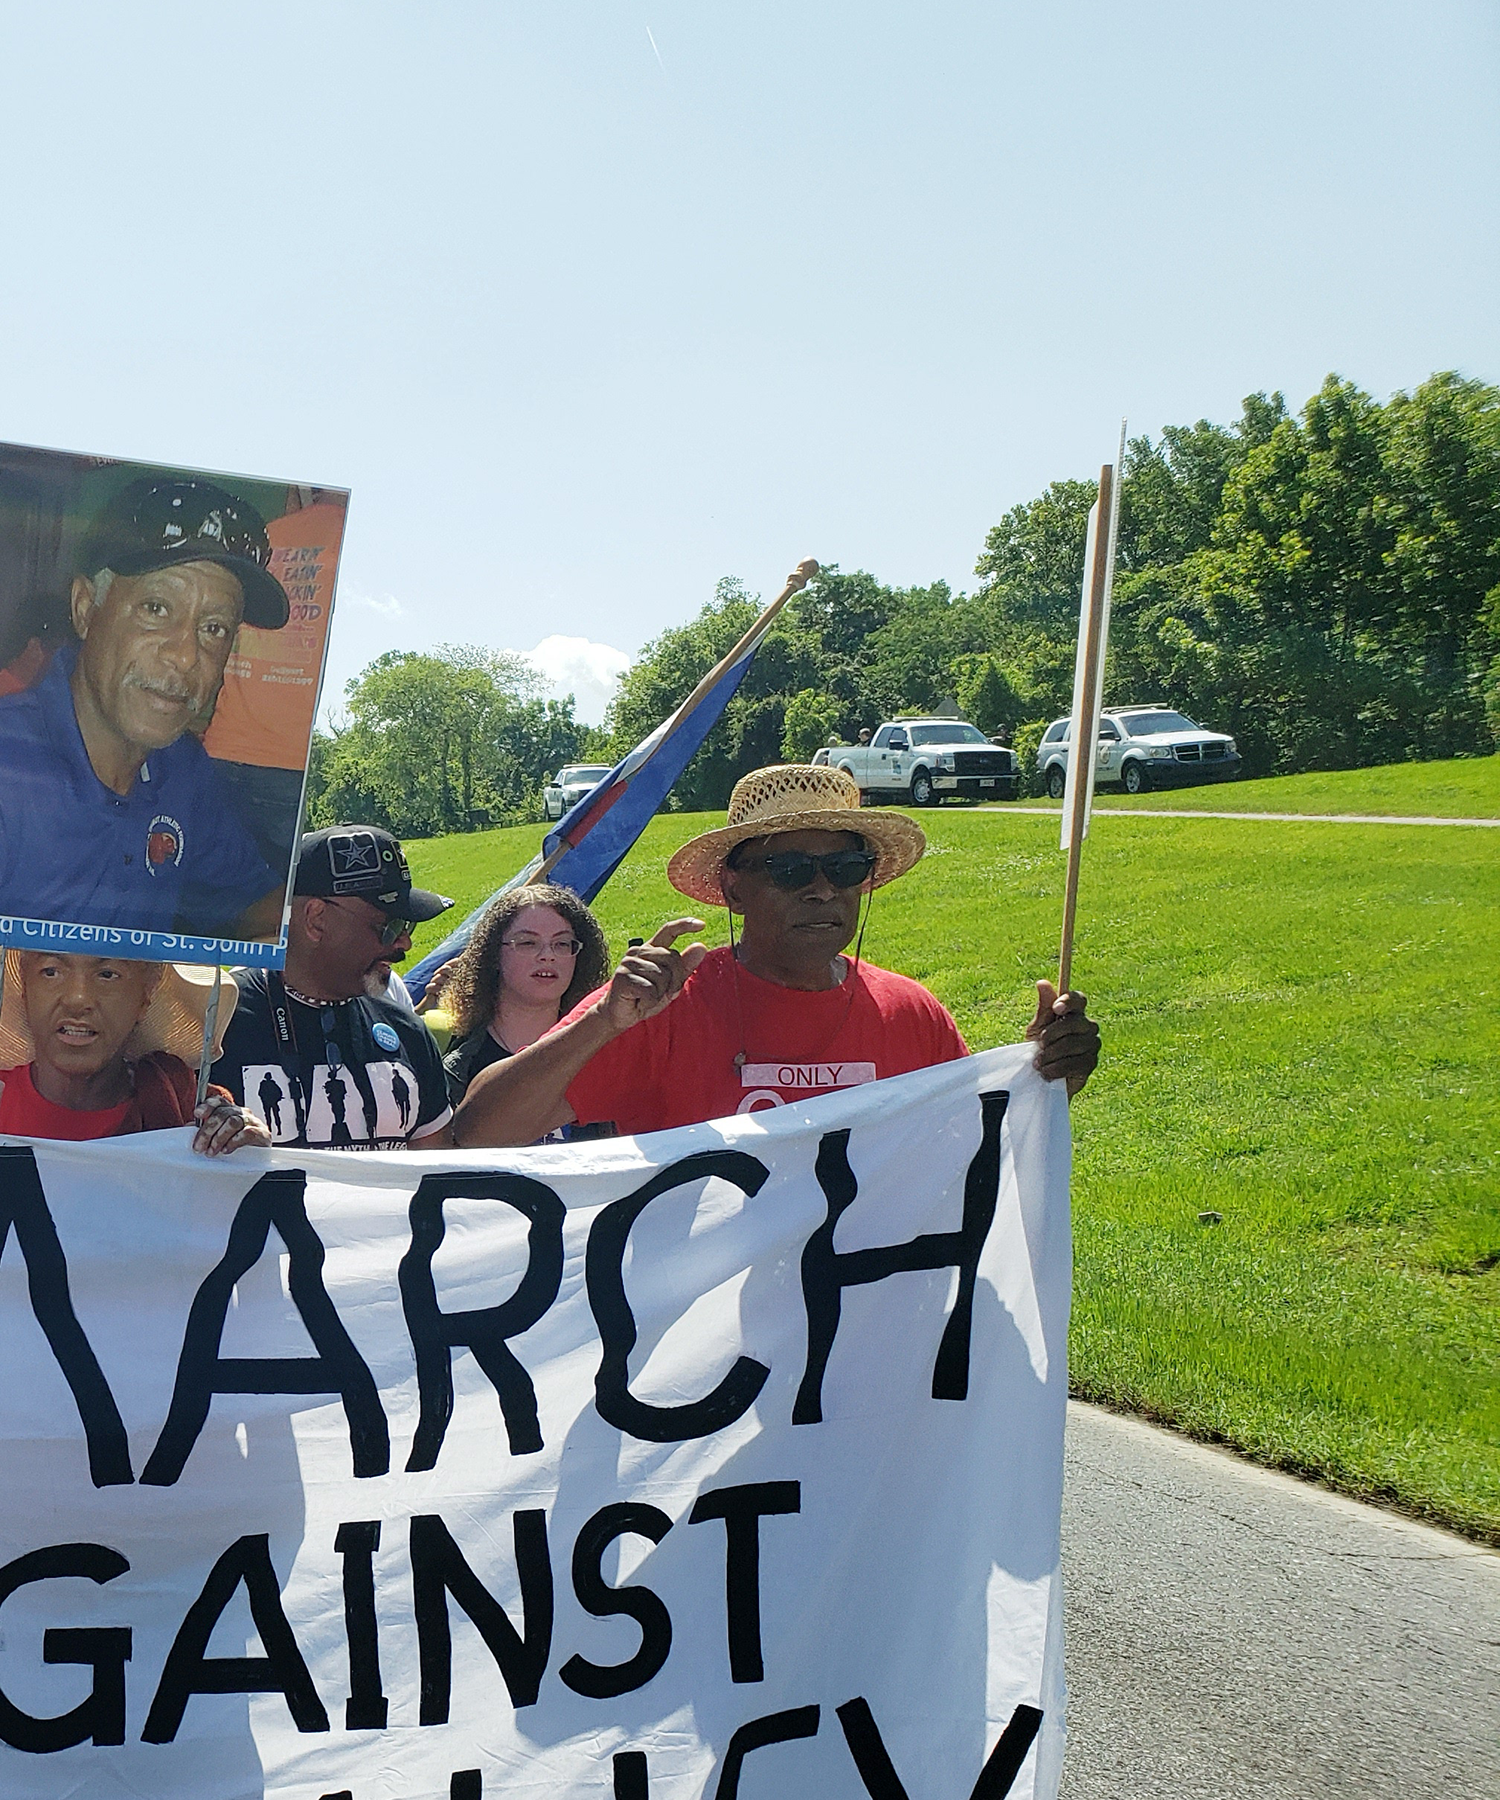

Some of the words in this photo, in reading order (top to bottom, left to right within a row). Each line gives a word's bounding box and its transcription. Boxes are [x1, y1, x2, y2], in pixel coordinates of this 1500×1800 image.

[276, 1007, 289, 1041] Canon
[777, 1065, 843, 1086] ONLY
[241, 1061, 420, 1143] DAD
